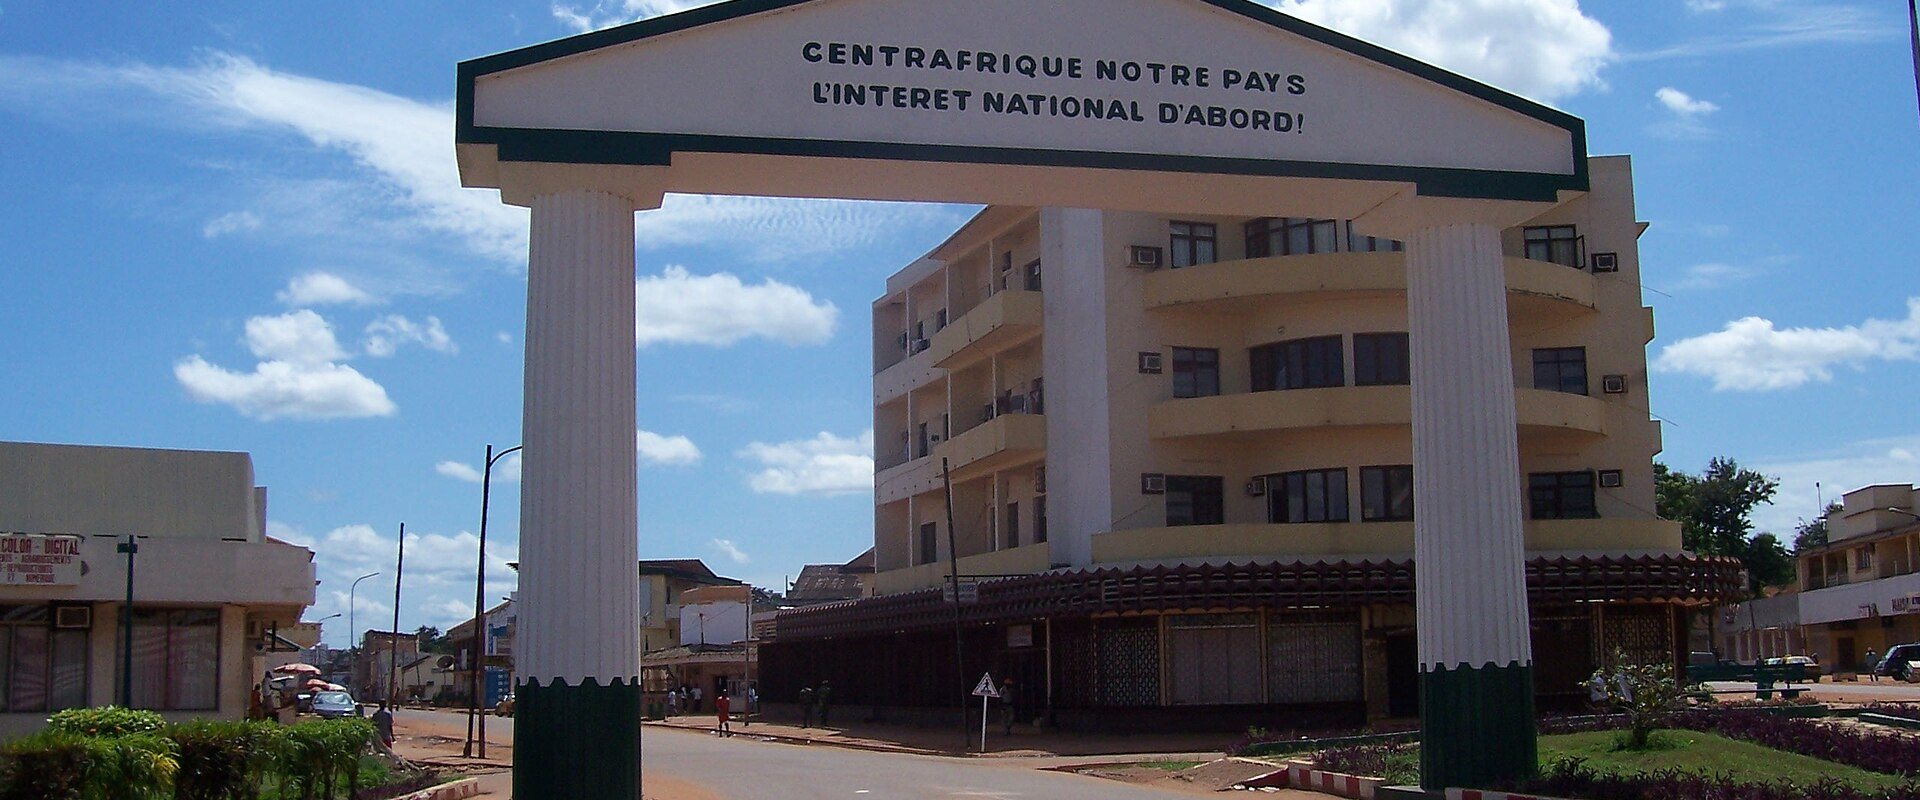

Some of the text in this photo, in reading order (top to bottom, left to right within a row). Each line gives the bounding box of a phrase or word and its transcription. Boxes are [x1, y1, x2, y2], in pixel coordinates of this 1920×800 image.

[801, 41, 1307, 95] CENTRAFRIQUE NOTRE PAYS
[812, 80, 1305, 134] L'INTERET NATIONAL D'ABORD!
[1, 538, 32, 553] COLOR
[44, 539, 80, 555] DIGITAL
